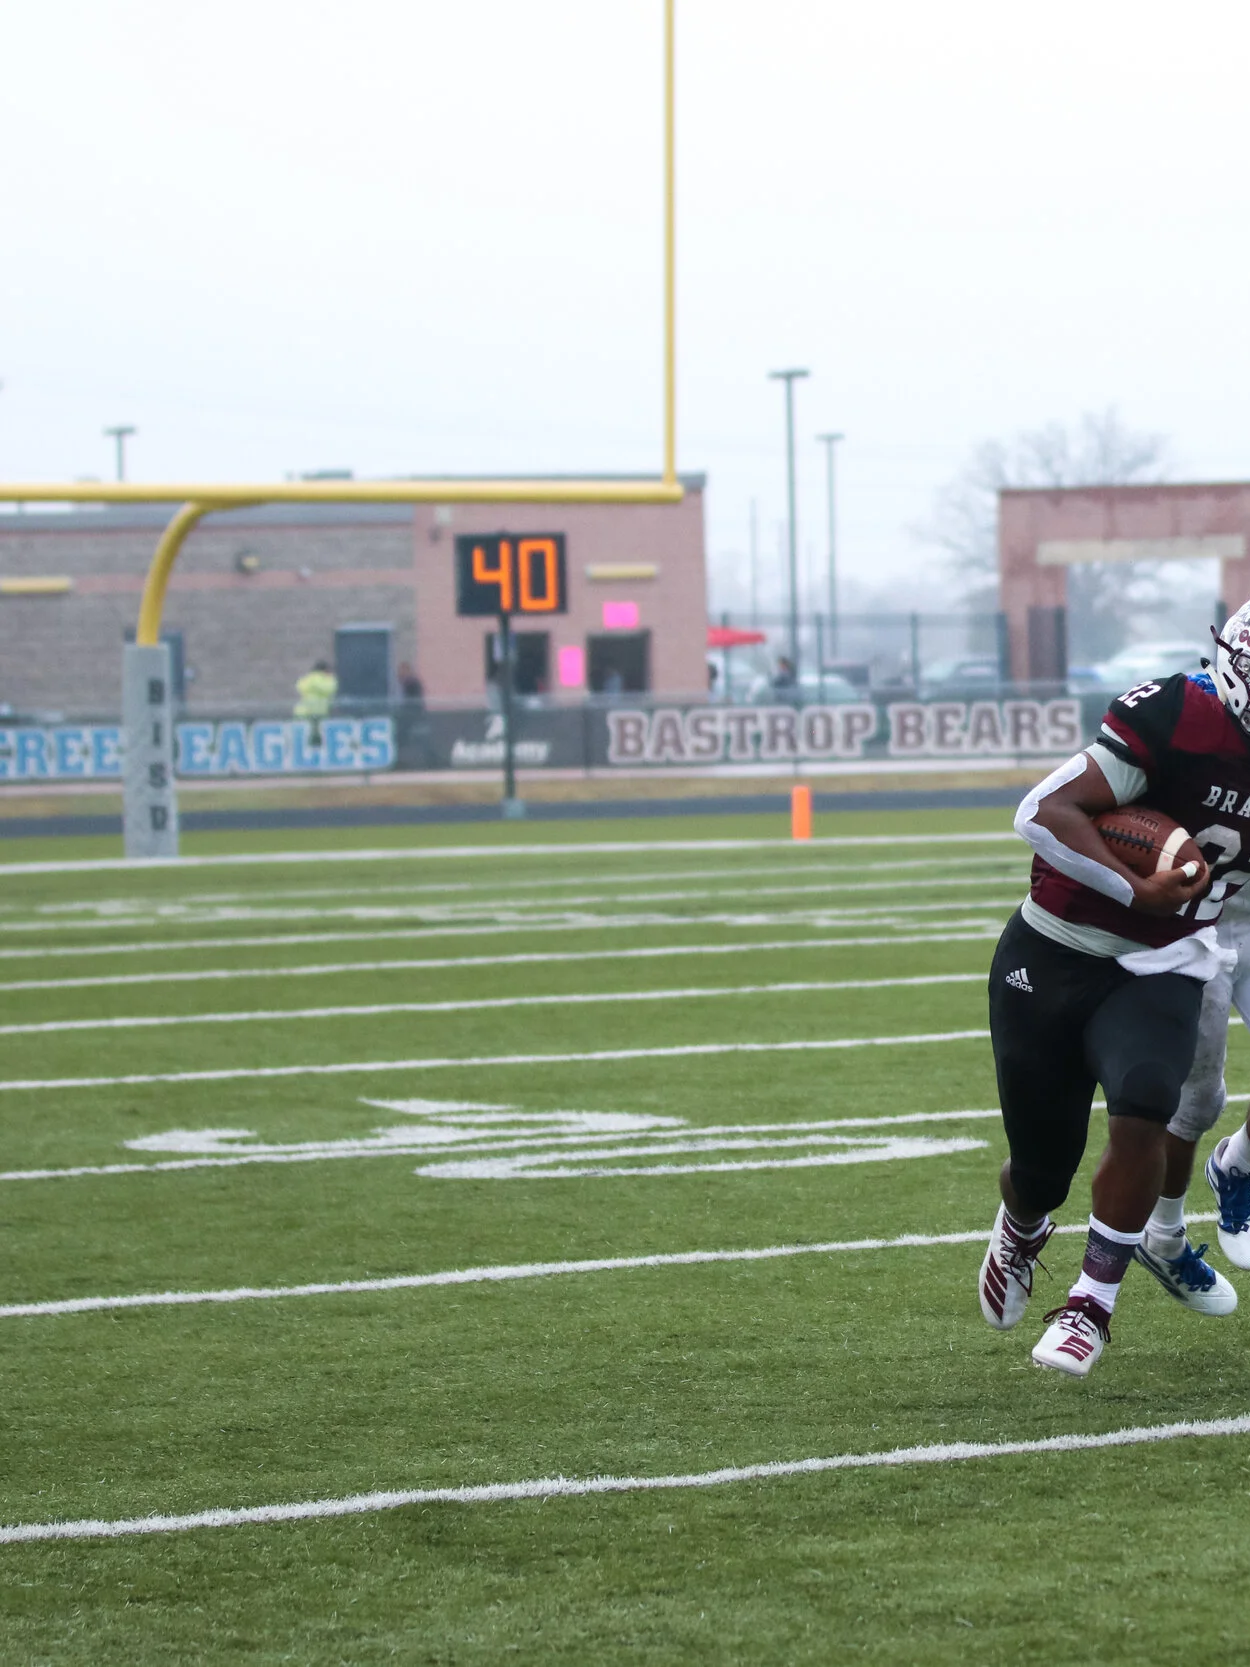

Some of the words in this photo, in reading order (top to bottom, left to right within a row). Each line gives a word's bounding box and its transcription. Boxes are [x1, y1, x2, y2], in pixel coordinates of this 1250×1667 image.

[472, 538, 558, 612] 40
[0, 726, 122, 778] REE
[176, 718, 397, 773] EAGLES
[452, 738, 549, 764] Acadmy
[607, 704, 877, 764] BASTROP
[888, 700, 1082, 756] BEARS
[1005, 974, 1034, 993] adidas
